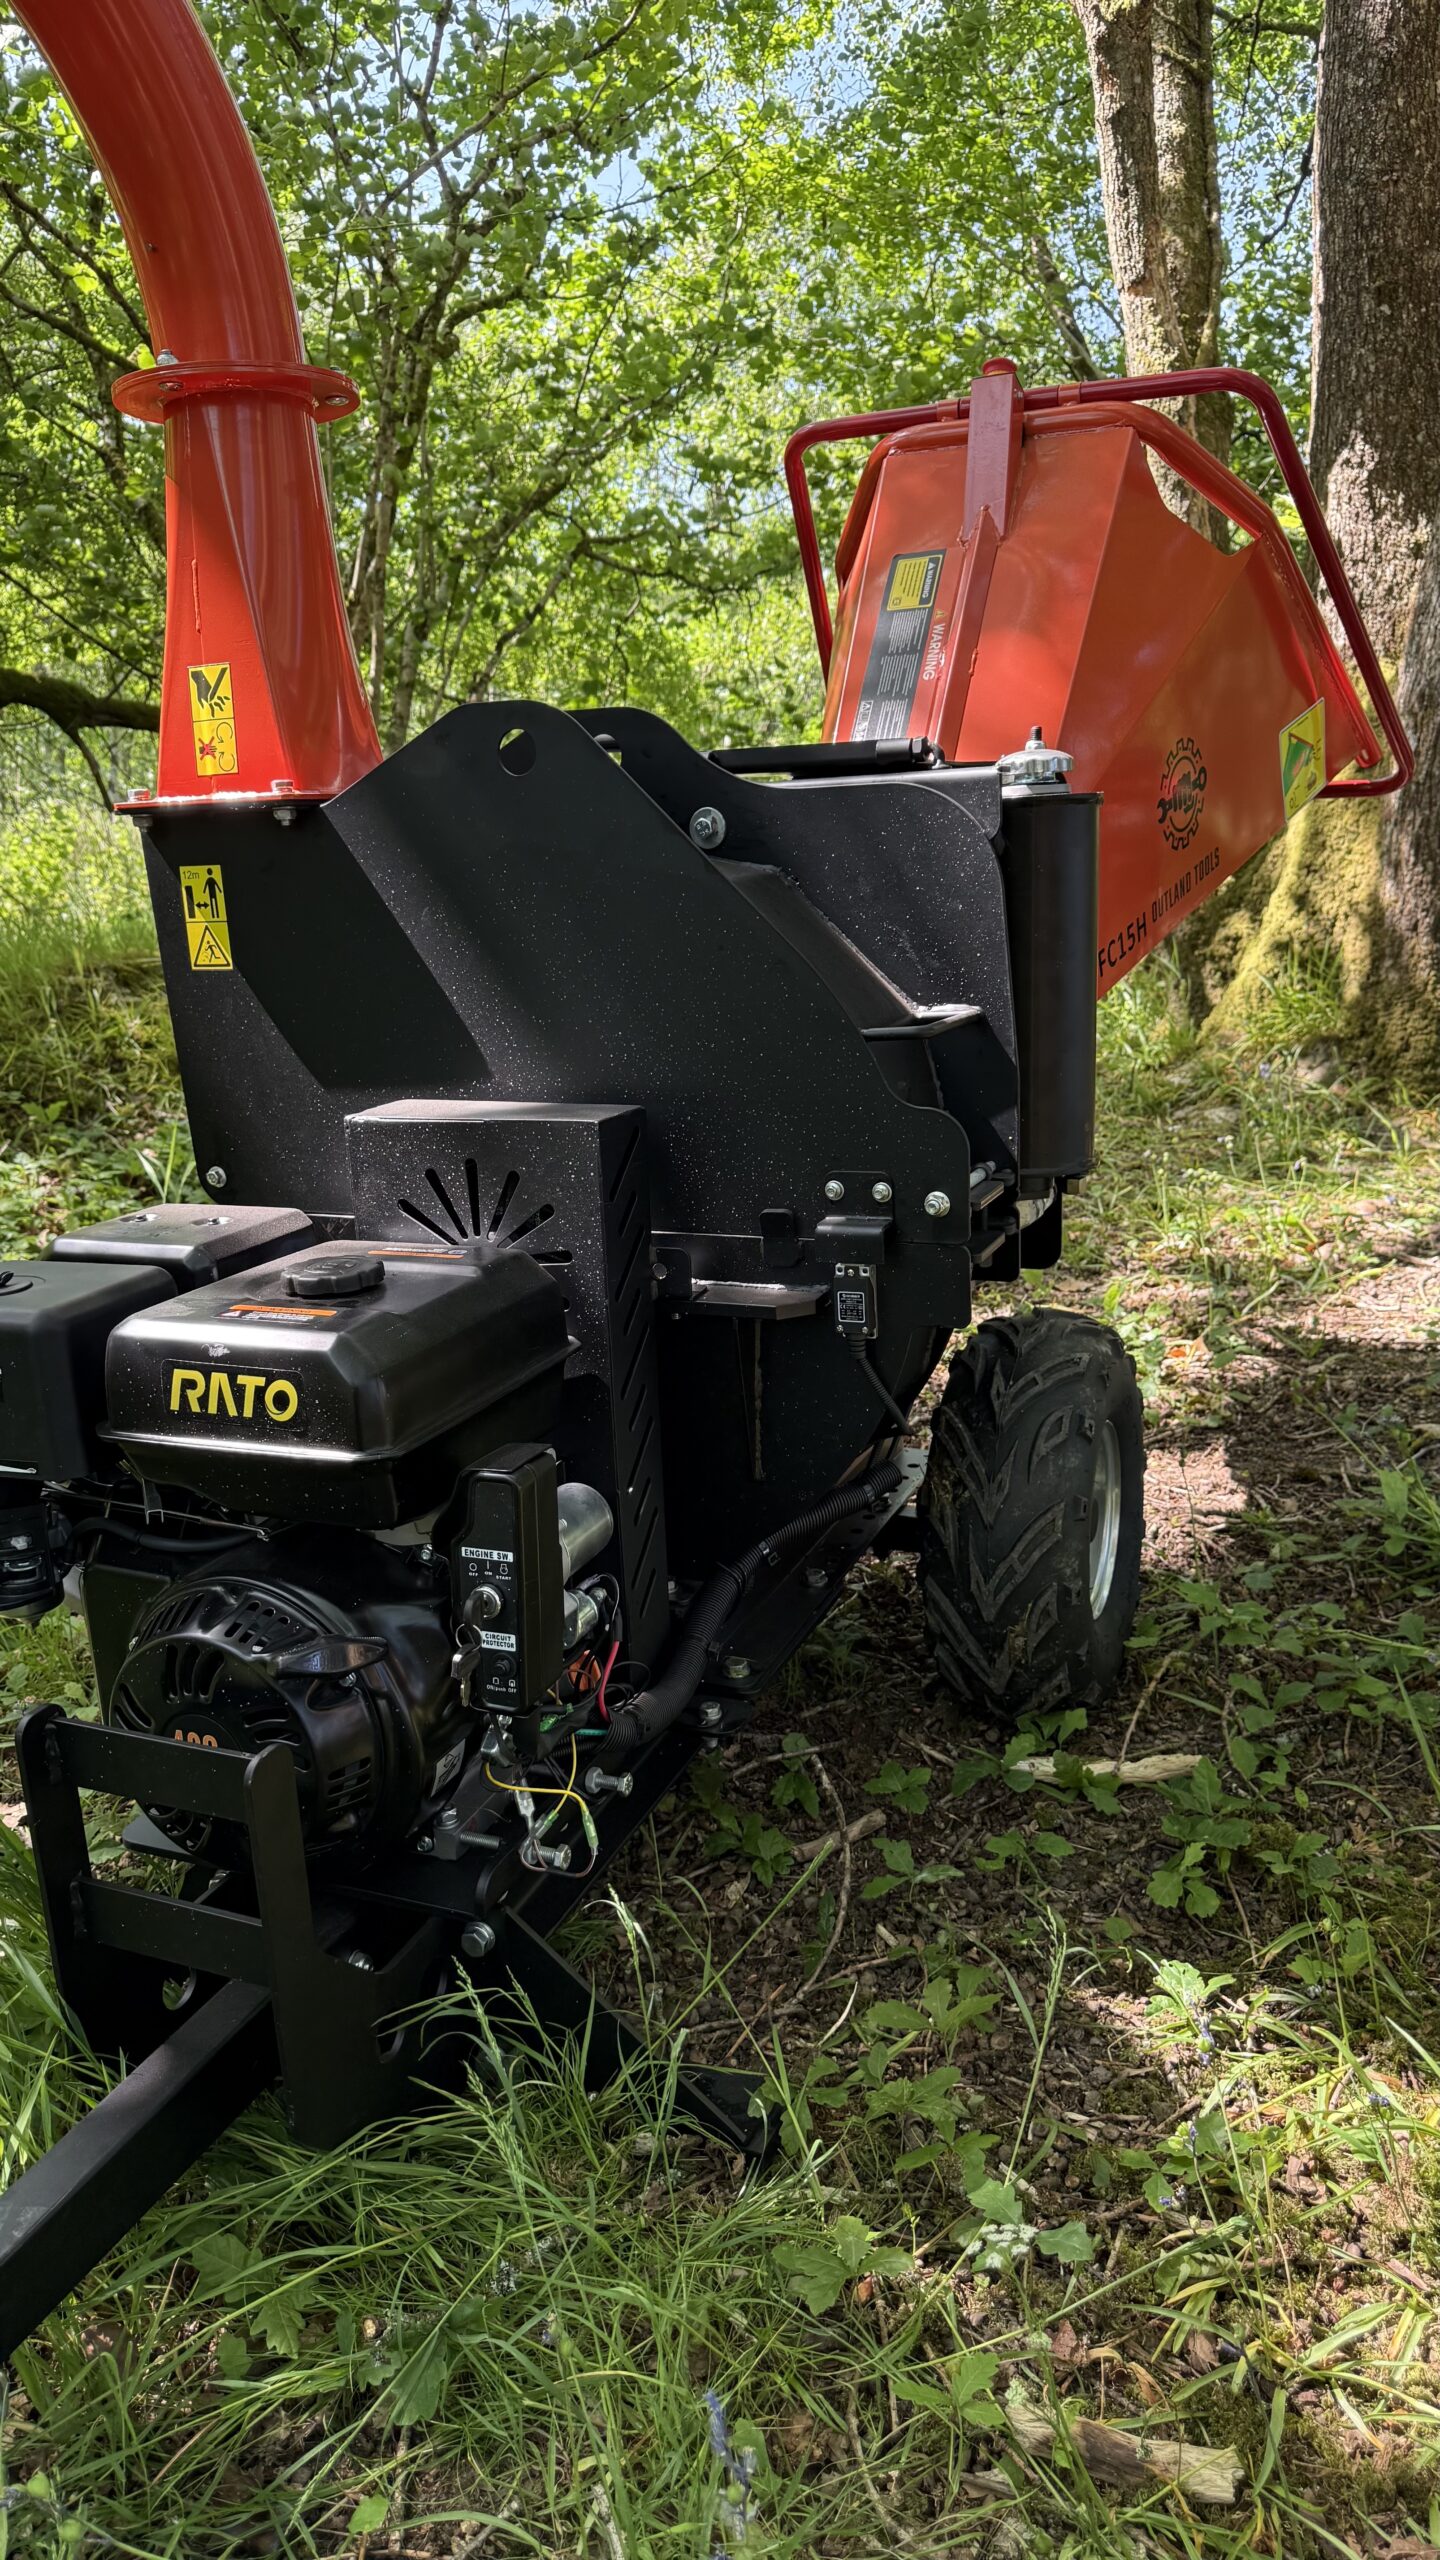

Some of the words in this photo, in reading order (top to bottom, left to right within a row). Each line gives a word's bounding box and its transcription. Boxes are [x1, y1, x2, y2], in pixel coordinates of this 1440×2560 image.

[922, 623, 945, 681] WARNING
[182, 870, 200, 880] 12m
[1098, 911, 1147, 977] FC15H
[1151, 871, 1191, 923] OUTLAND
[1193, 847, 1220, 885] TOOLS
[169, 1368, 298, 1422] RATO
[464, 1548, 494, 1559] ENGINE
[484, 1633, 511, 1642] CIRCUIT
[482, 1640, 515, 1649] PROTECTOR
